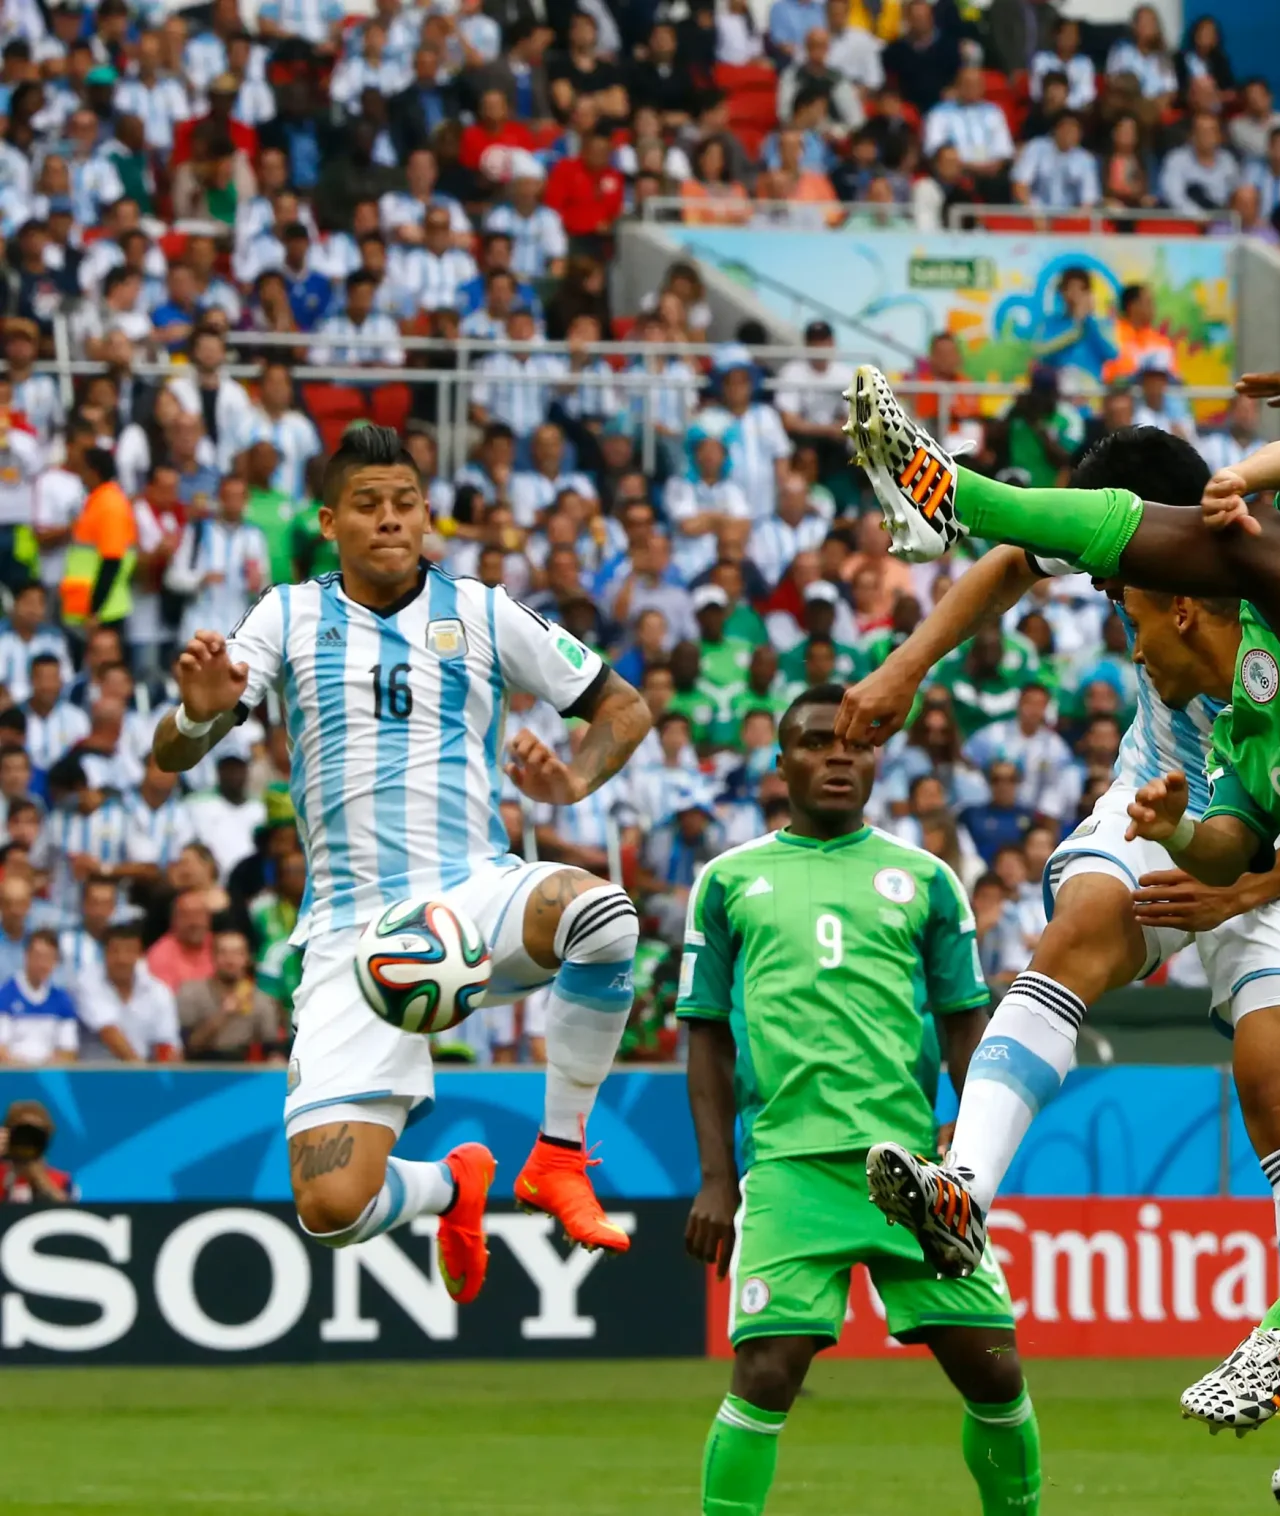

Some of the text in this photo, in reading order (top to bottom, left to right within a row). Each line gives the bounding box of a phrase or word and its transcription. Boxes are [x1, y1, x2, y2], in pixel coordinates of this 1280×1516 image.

[368, 663, 413, 719] 16
[816, 914, 843, 969] 9
[1, 1208, 636, 1351] SONY
